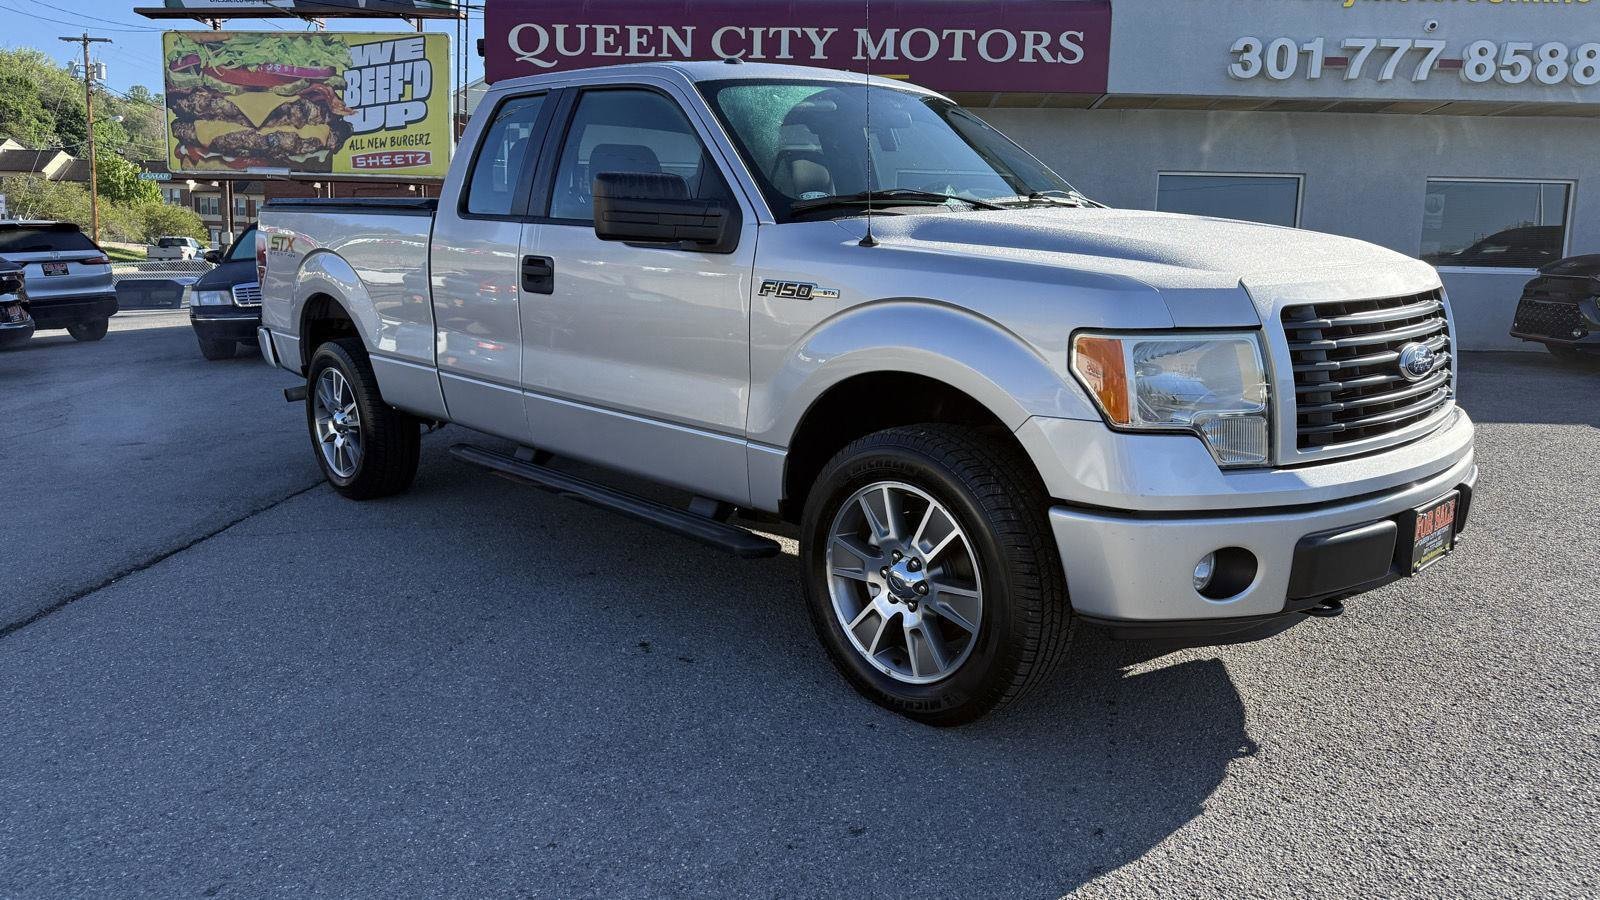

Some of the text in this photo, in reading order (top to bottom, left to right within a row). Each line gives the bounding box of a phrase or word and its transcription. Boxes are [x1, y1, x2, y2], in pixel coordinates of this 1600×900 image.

[349, 36, 424, 68] WE
[508, 23, 1084, 68] QUEEN CITY MOTORS
[343, 60, 432, 108] BEEF'D
[344, 101, 427, 132] UP
[349, 133, 431, 150] ALL NEW BURGERZ
[356, 153, 426, 167] SHEETZ
[271, 236, 296, 252] STX
[1415, 510, 1433, 541] FOR
